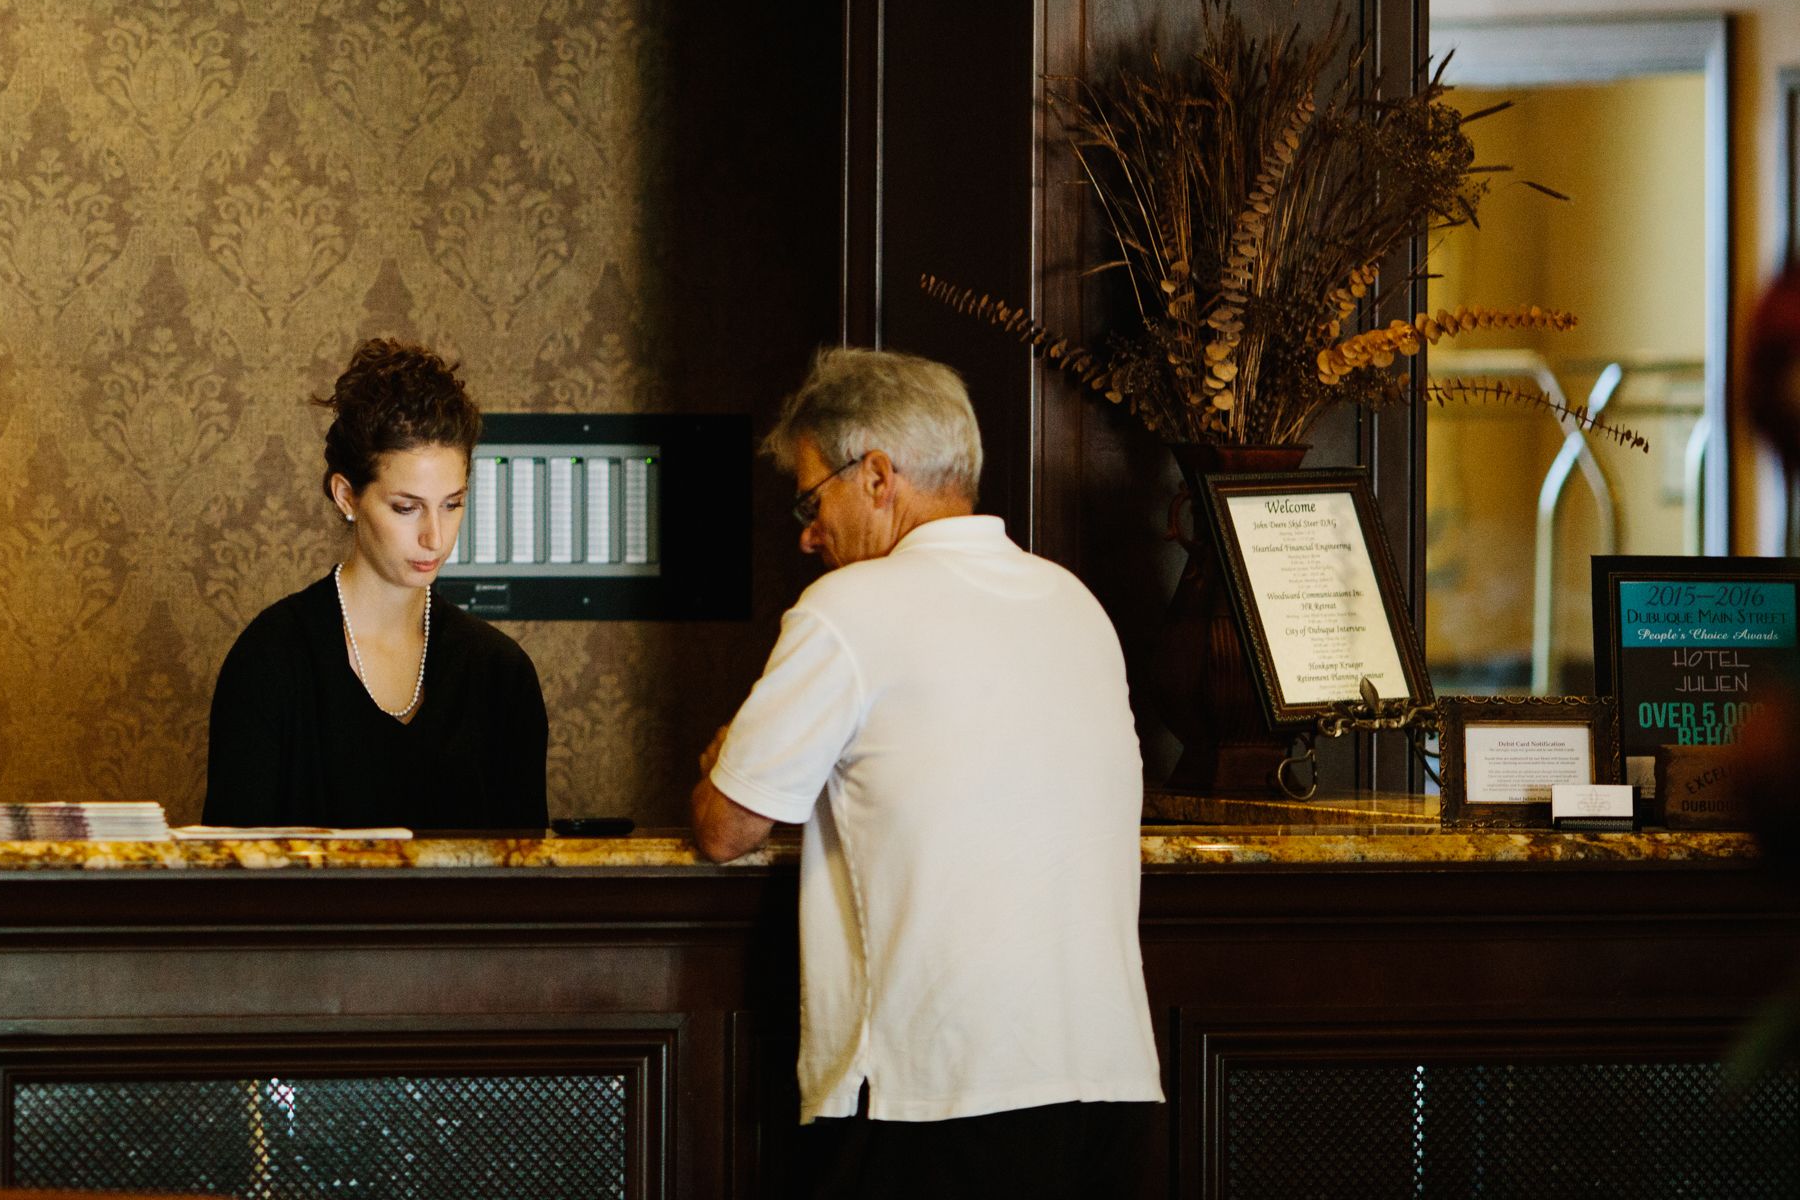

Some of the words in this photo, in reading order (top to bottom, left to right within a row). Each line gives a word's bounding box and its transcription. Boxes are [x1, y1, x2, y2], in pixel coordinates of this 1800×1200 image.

[1265, 499, 1316, 514] Welcome
[1254, 520, 1268, 530] John
[1270, 520, 1286, 529] Deere
[1252, 543, 1283, 553] Heartland
[1285, 542, 1314, 551] Financial
[1315, 542, 1352, 552] Engineering
[1267, 591, 1300, 600] Woodward
[1302, 589, 1352, 600] Communications
[1637, 628, 1686, 643] People's
[1689, 628, 1729, 641] Choice
[1732, 628, 1779, 641] Awards
[1672, 648, 1751, 670] HOTEL
[1296, 674, 1329, 683] Retirement
[1331, 673, 1359, 682] Planning
[1675, 672, 1749, 693] JULIEN
[1638, 701, 1697, 729] OVER
[1498, 740, 1515, 748] Debit
[1516, 740, 1530, 748] Card
[1531, 740, 1566, 748] Notification
